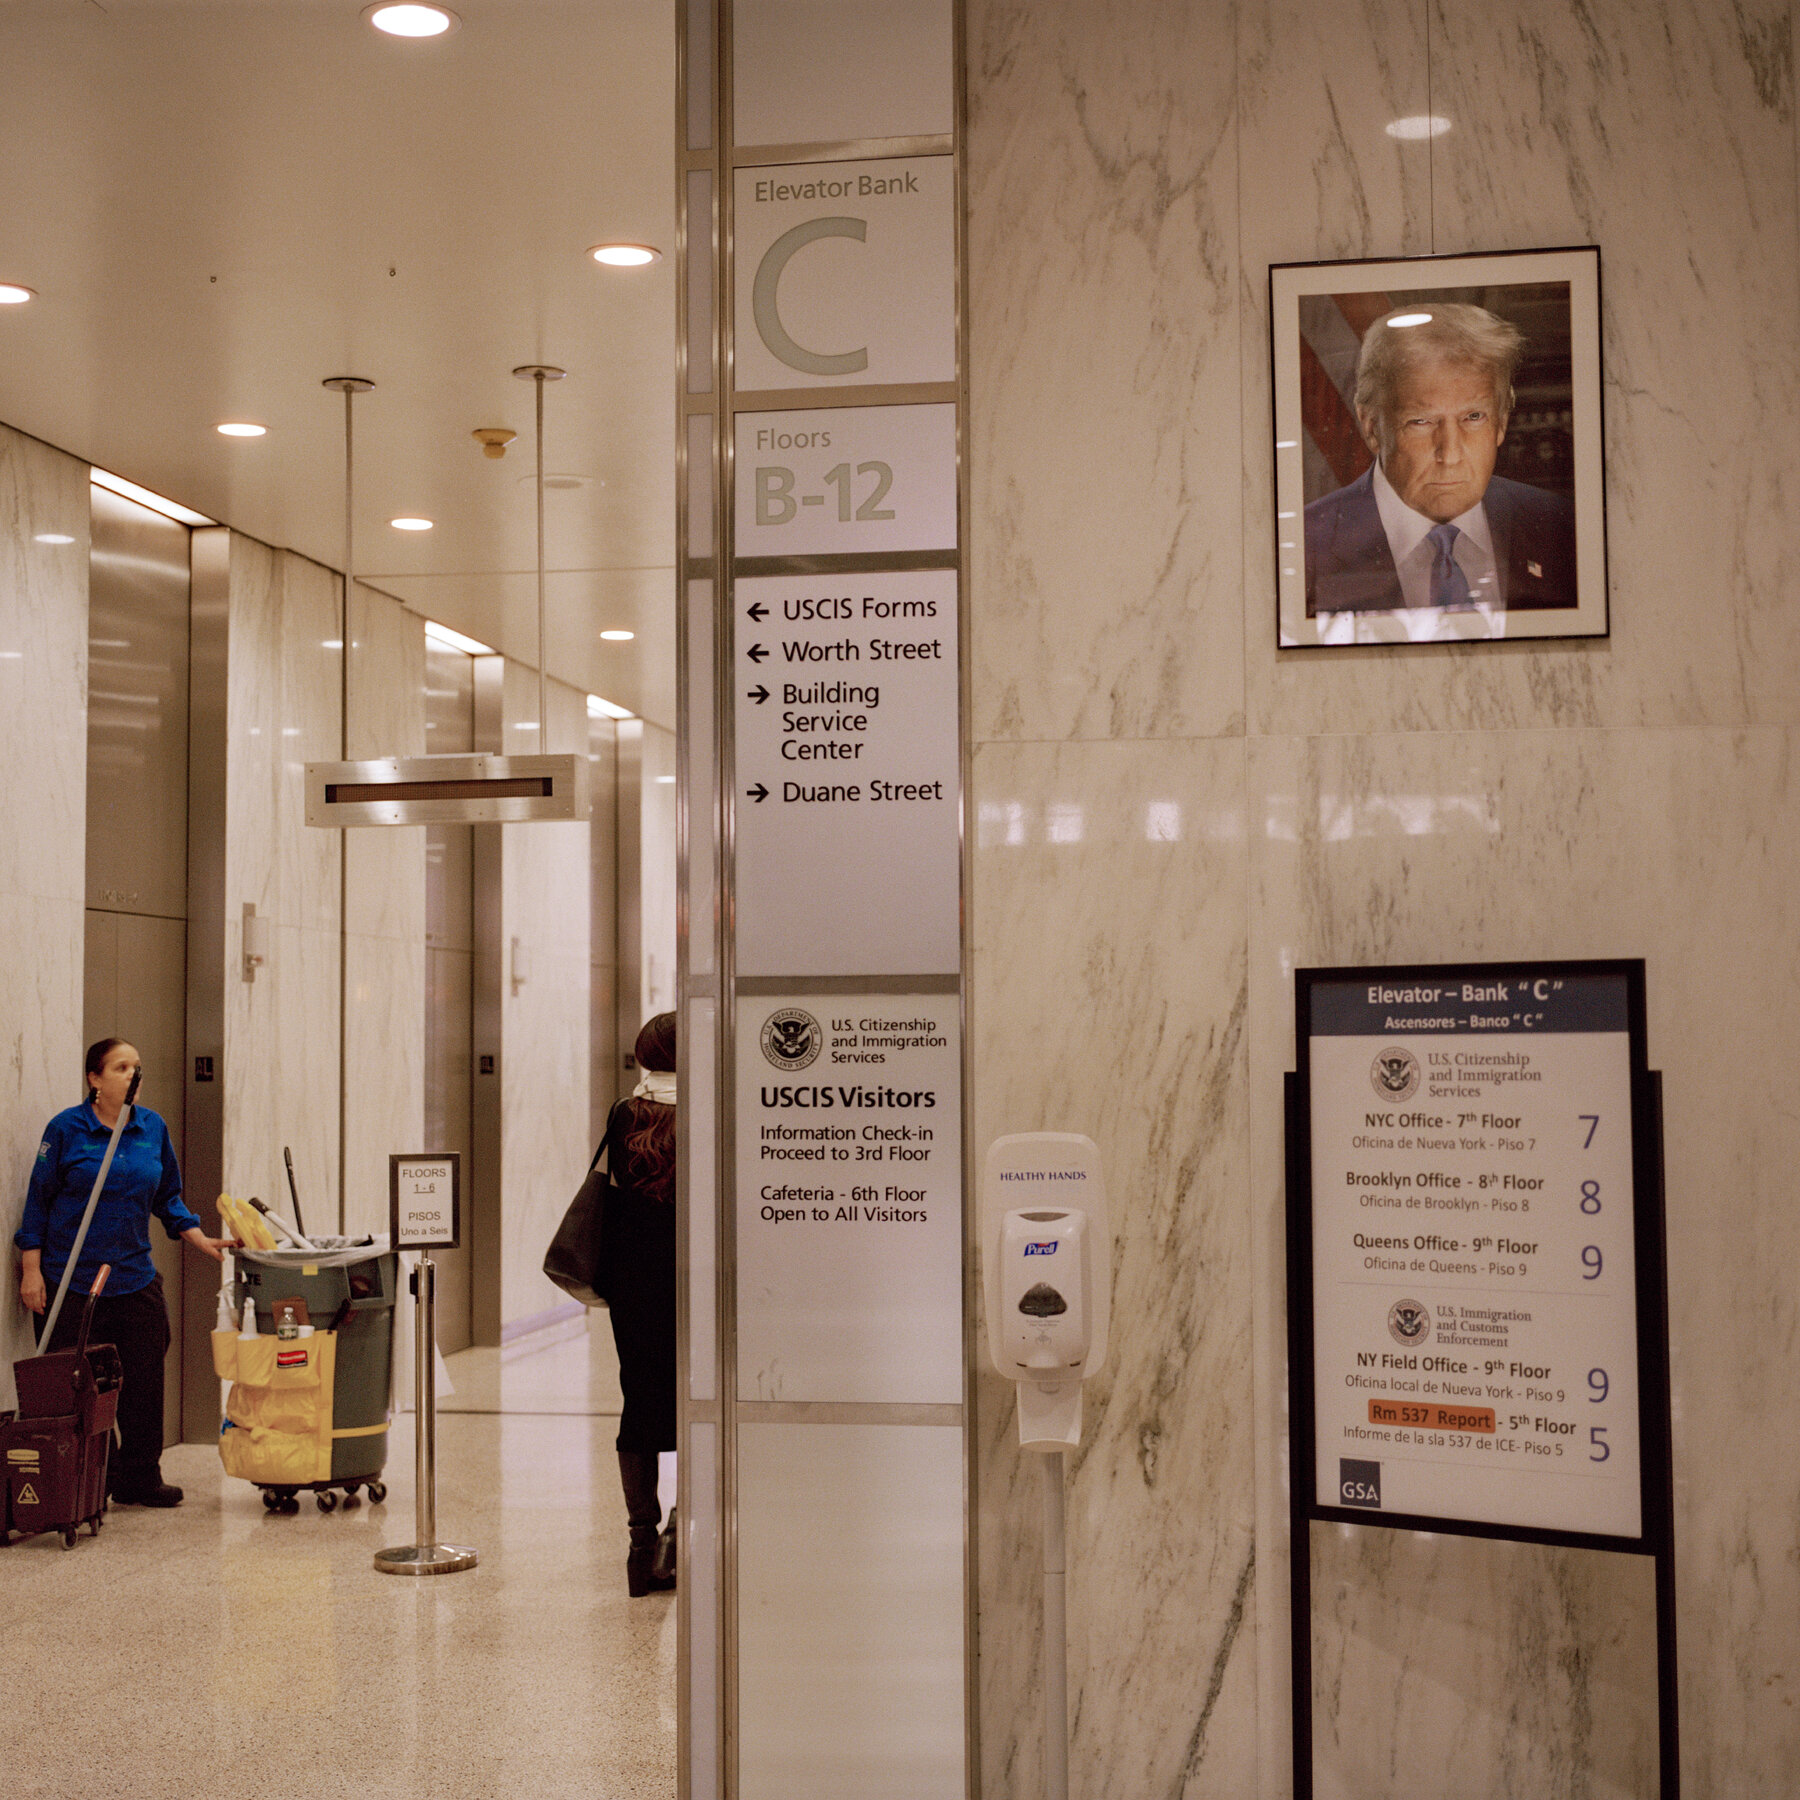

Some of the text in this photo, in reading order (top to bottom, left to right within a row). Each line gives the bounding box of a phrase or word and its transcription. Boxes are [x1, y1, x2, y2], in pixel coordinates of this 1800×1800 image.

[756, 171, 918, 202] Elevator Bank
[752, 216, 868, 376] C
[757, 428, 831, 450] Floors
[755, 461, 895, 526] B-12
[784, 598, 936, 620] USCIS Forms
[782, 639, 941, 662] Worth Street
[784, 681, 879, 708] Building
[783, 710, 867, 732] Service
[782, 740, 863, 760] Center
[784, 780, 942, 802] Duane Street
[1368, 986, 1441, 1003] Elevator
[1462, 983, 1508, 1001] Bank
[832, 1018, 936, 1033] U.S. Citizenship
[1385, 1017, 1455, 1028] Ascensores
[1470, 1015, 1509, 1027] Banco
[832, 1035, 946, 1050] and Immigration
[832, 1051, 885, 1063] Services
[1428, 1052, 1530, 1070] U.S. Citizenship
[1429, 1067, 1541, 1085] and Immigration
[762, 1086, 935, 1107] USCIS Visitors
[1429, 1085, 1480, 1097] Services
[1366, 1114, 1394, 1127] NYC
[1399, 1113, 1443, 1128] Office
[1457, 1113, 1476, 1127] 7th
[1482, 1114, 1521, 1128] Floor
[762, 1125, 933, 1140] Information Check-in
[1579, 1115, 1599, 1149] 7
[1352, 1136, 1394, 1148] Oficina
[1397, 1136, 1413, 1149] de
[1417, 1137, 1455, 1149] Nueva
[1460, 1137, 1486, 1150] York
[1498, 1138, 1524, 1150] Piso
[1528, 1138, 1535, 1150] 7
[761, 1146, 930, 1160] Proceed to 3rd Floor
[403, 1168, 446, 1178] FLOORS
[1001, 1172, 1086, 1180] HEALTHY HANDS
[1347, 1172, 1411, 1189] Brooklyn
[1416, 1173, 1460, 1188] Office
[1504, 1175, 1544, 1190] Floor
[415, 1184, 419, 1193] 1
[429, 1183, 435, 1193] 6
[761, 1185, 833, 1200] Cafeteria
[852, 1186, 878, 1201] 6th
[886, 1186, 926, 1201] Floor
[1580, 1180, 1601, 1214] 8
[1360, 1195, 1401, 1207] Oficina
[1406, 1196, 1421, 1208] de
[1425, 1197, 1479, 1212] Brooklyn
[1492, 1199, 1518, 1211] Piso
[1522, 1199, 1529, 1212] 8
[408, 1211, 441, 1221] PISOS
[761, 1206, 927, 1224] Open to All Visitors
[401, 1228, 419, 1236] Uno
[430, 1227, 448, 1235] Seis
[1028, 1243, 1055, 1254] Purell
[1354, 1234, 1409, 1249] Queens
[1414, 1236, 1458, 1251] Office
[1473, 1237, 1492, 1252] 9th
[1498, 1239, 1538, 1254] Floor
[1364, 1257, 1406, 1270] Oficina
[1410, 1259, 1425, 1271] de
[1429, 1260, 1477, 1274] Queens
[1489, 1262, 1515, 1275] Piso
[1519, 1263, 1526, 1276] 9
[1582, 1245, 1602, 1280] 9
[1437, 1306, 1531, 1325] U.S. Immigration
[1437, 1320, 1508, 1333] and Customs
[1437, 1332, 1507, 1347] Enforcement
[1358, 1353, 1377, 1366] NY
[1382, 1354, 1417, 1370] Field
[1423, 1357, 1467, 1373] Office
[1485, 1360, 1504, 1375] 9th
[1510, 1363, 1551, 1379] Floor
[1345, 1375, 1386, 1389] Oficina
[1391, 1377, 1419, 1392] local
[1423, 1381, 1438, 1393] de
[1442, 1382, 1481, 1396] Nueva
[1486, 1385, 1513, 1398] York
[1527, 1388, 1552, 1401] Piso
[1557, 1390, 1564, 1402] 9
[1588, 1368, 1609, 1403] 9
[1373, 1405, 1396, 1420] Rm
[1402, 1408, 1428, 1422] 537
[1438, 1410, 1490, 1429] Report
[1510, 1415, 1529, 1430] 5th
[1536, 1418, 1576, 1434] Floor
[1344, 1426, 1390, 1441] Informe
[1395, 1430, 1410, 1443] de
[1414, 1431, 1424, 1444] la
[1428, 1433, 1444, 1446] sla
[1449, 1435, 1472, 1448] 537
[1476, 1437, 1491, 1449] de
[1525, 1441, 1551, 1455] Piso
[1556, 1444, 1563, 1456] 5
[1590, 1427, 1610, 1462] 5
[1342, 1481, 1379, 1501] GSA
